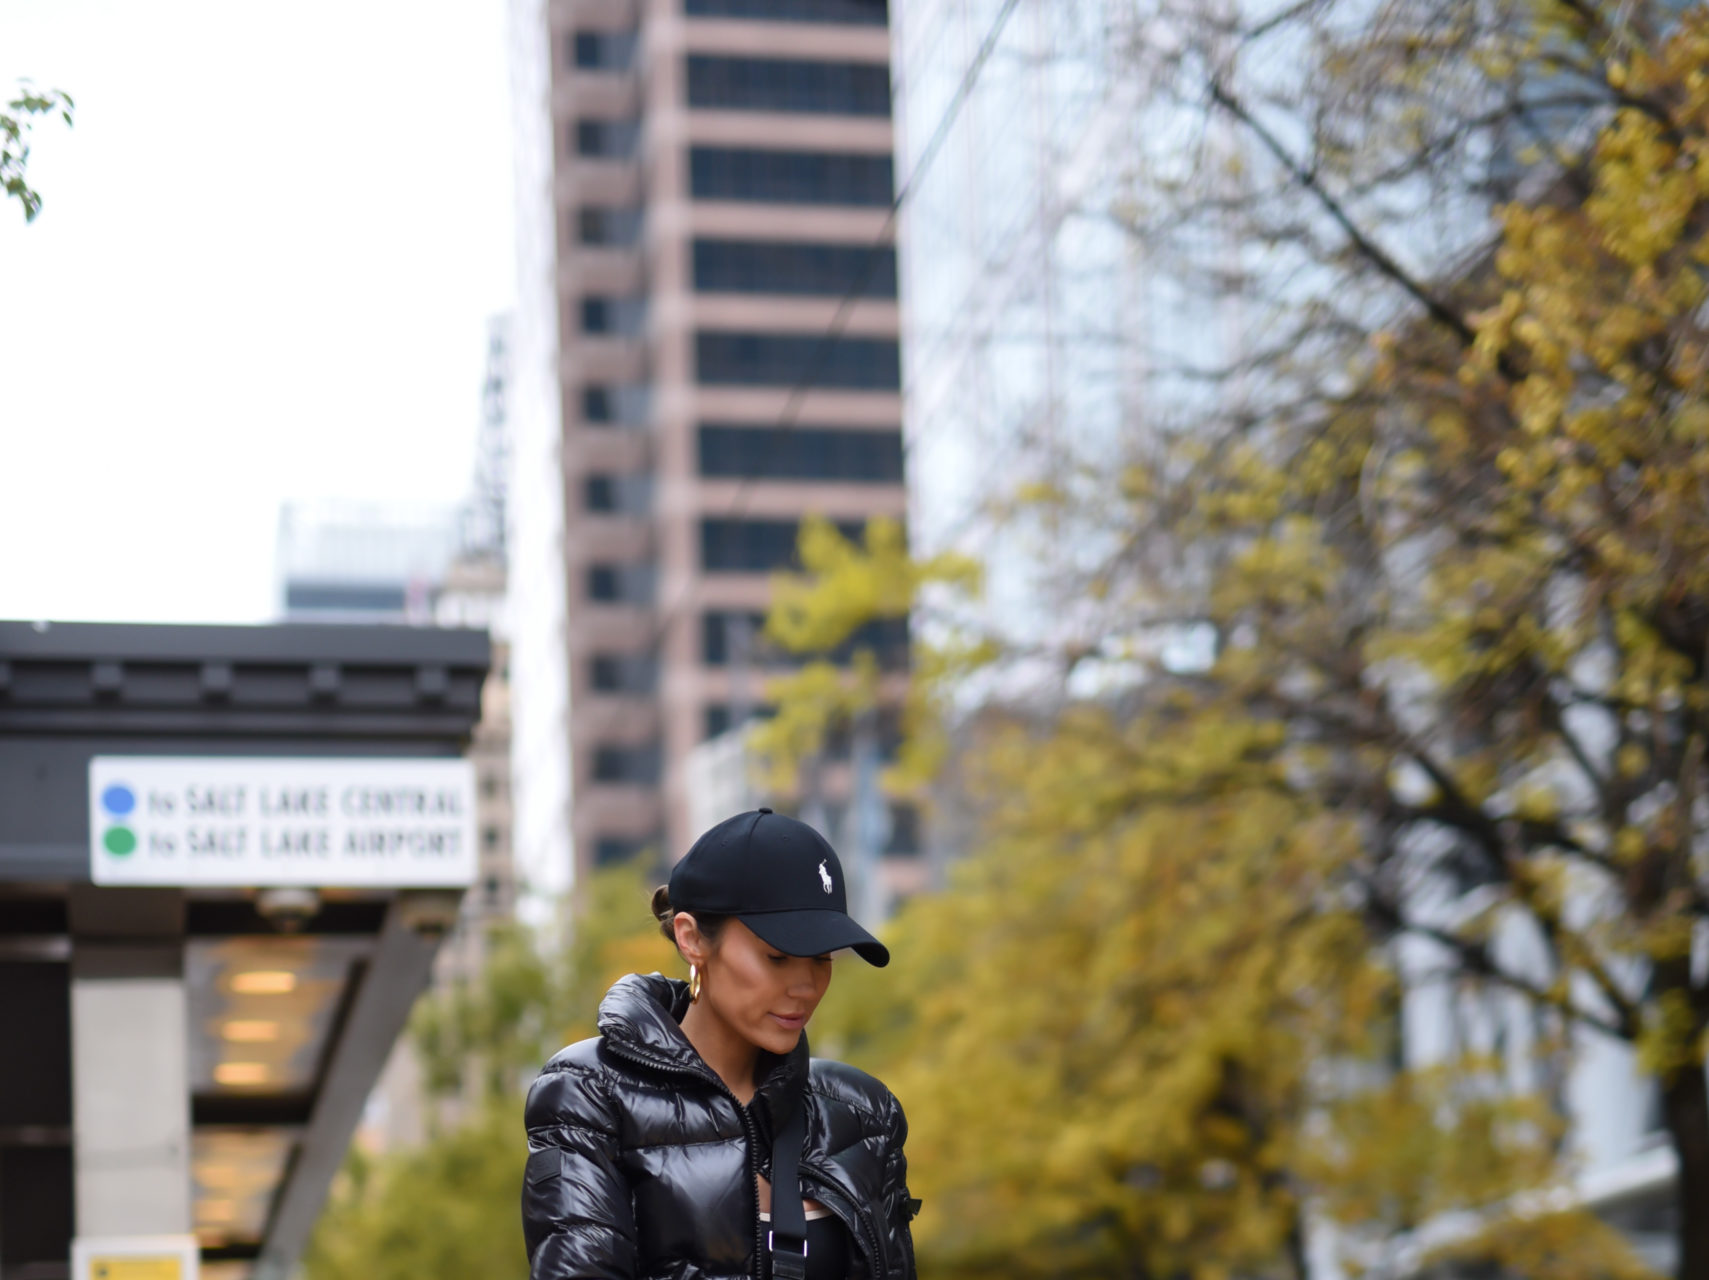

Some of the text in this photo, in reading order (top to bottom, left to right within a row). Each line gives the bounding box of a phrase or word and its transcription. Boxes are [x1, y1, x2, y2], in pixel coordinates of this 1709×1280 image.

[184, 785, 247, 816] SALT
[259, 785, 329, 816] LAKE
[341, 785, 464, 816] CENTRAL
[184, 825, 247, 857] SALT
[259, 825, 329, 857] LAKE
[341, 825, 464, 858] AIRPORT
